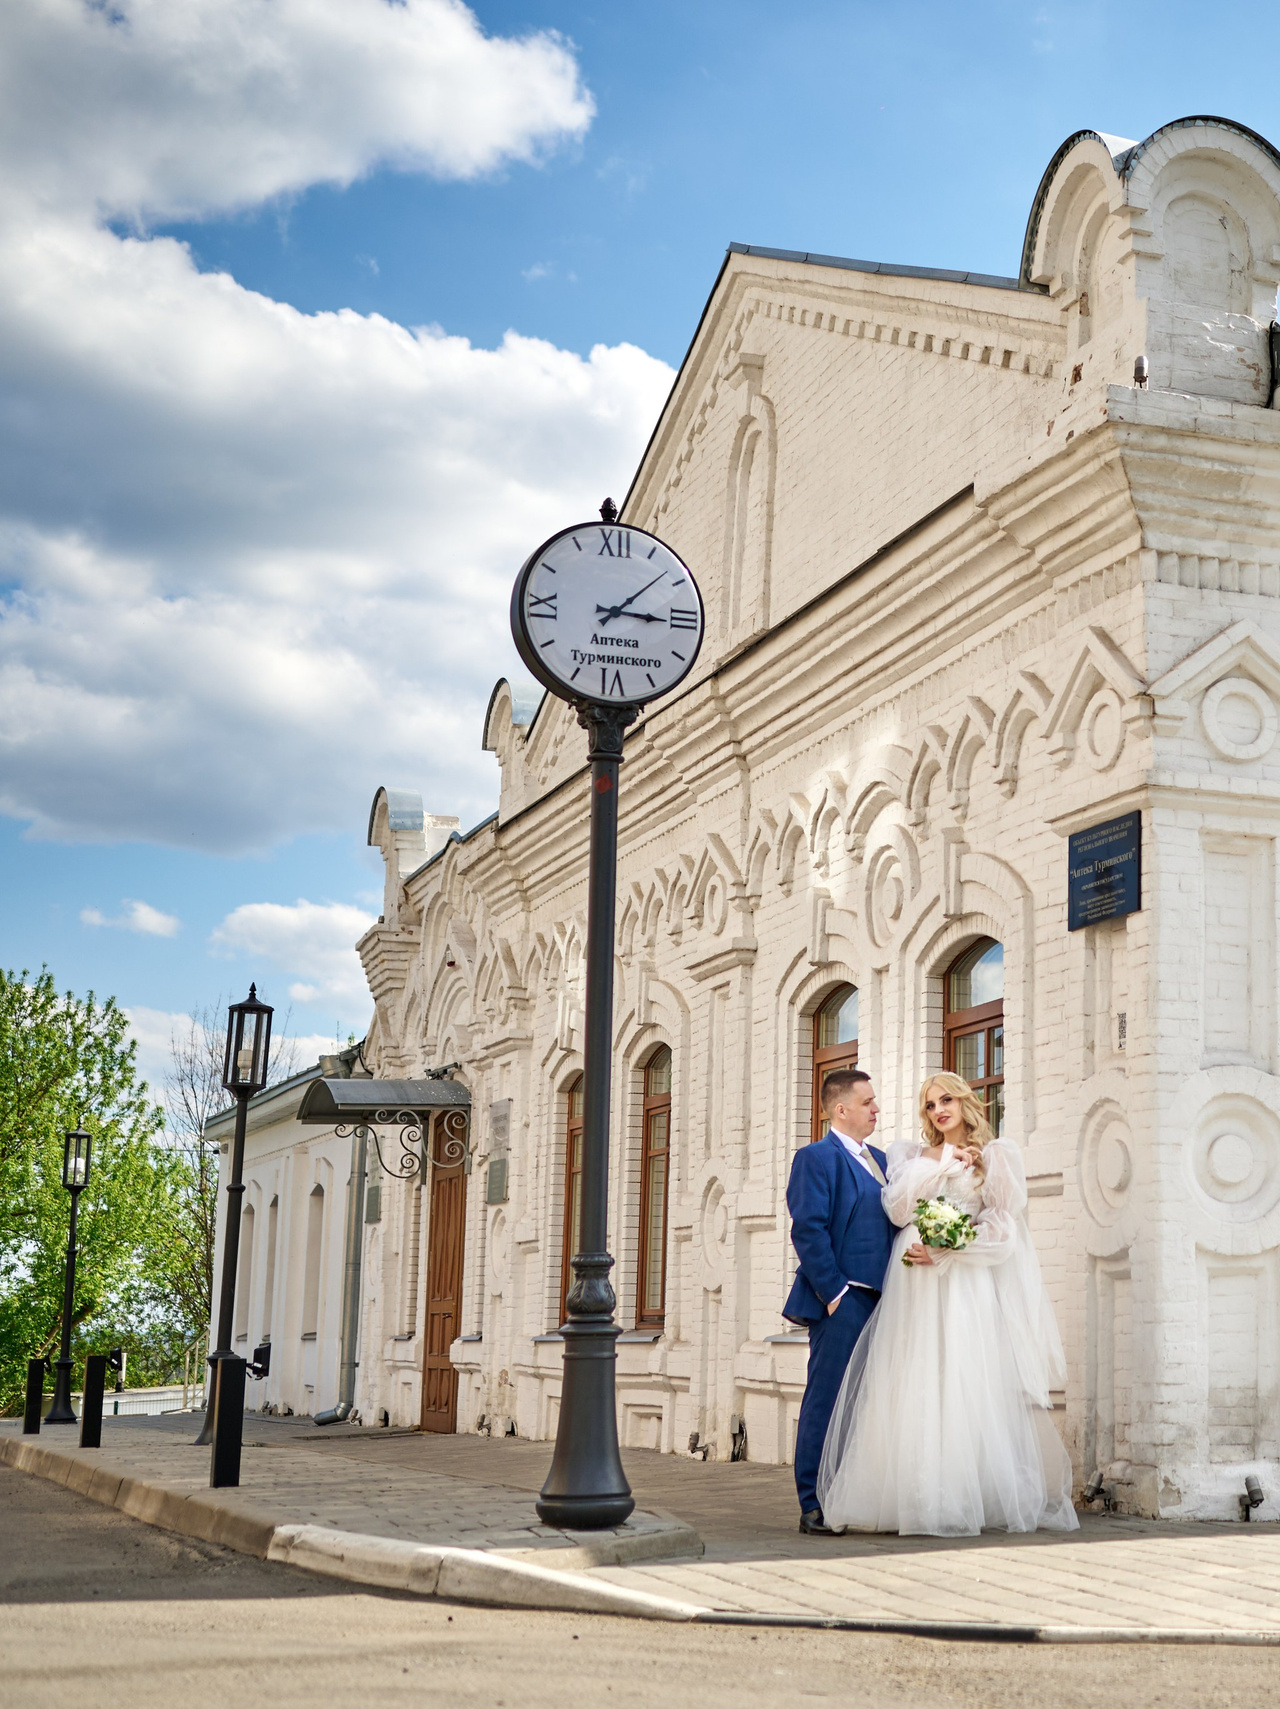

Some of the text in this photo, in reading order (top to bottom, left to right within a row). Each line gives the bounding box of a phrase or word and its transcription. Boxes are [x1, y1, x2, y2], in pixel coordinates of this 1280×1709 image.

[597, 528, 632, 559] XII
[669, 607, 698, 631] III
[590, 633, 639, 649] Аптека
[570, 649, 662, 669] Турминского
